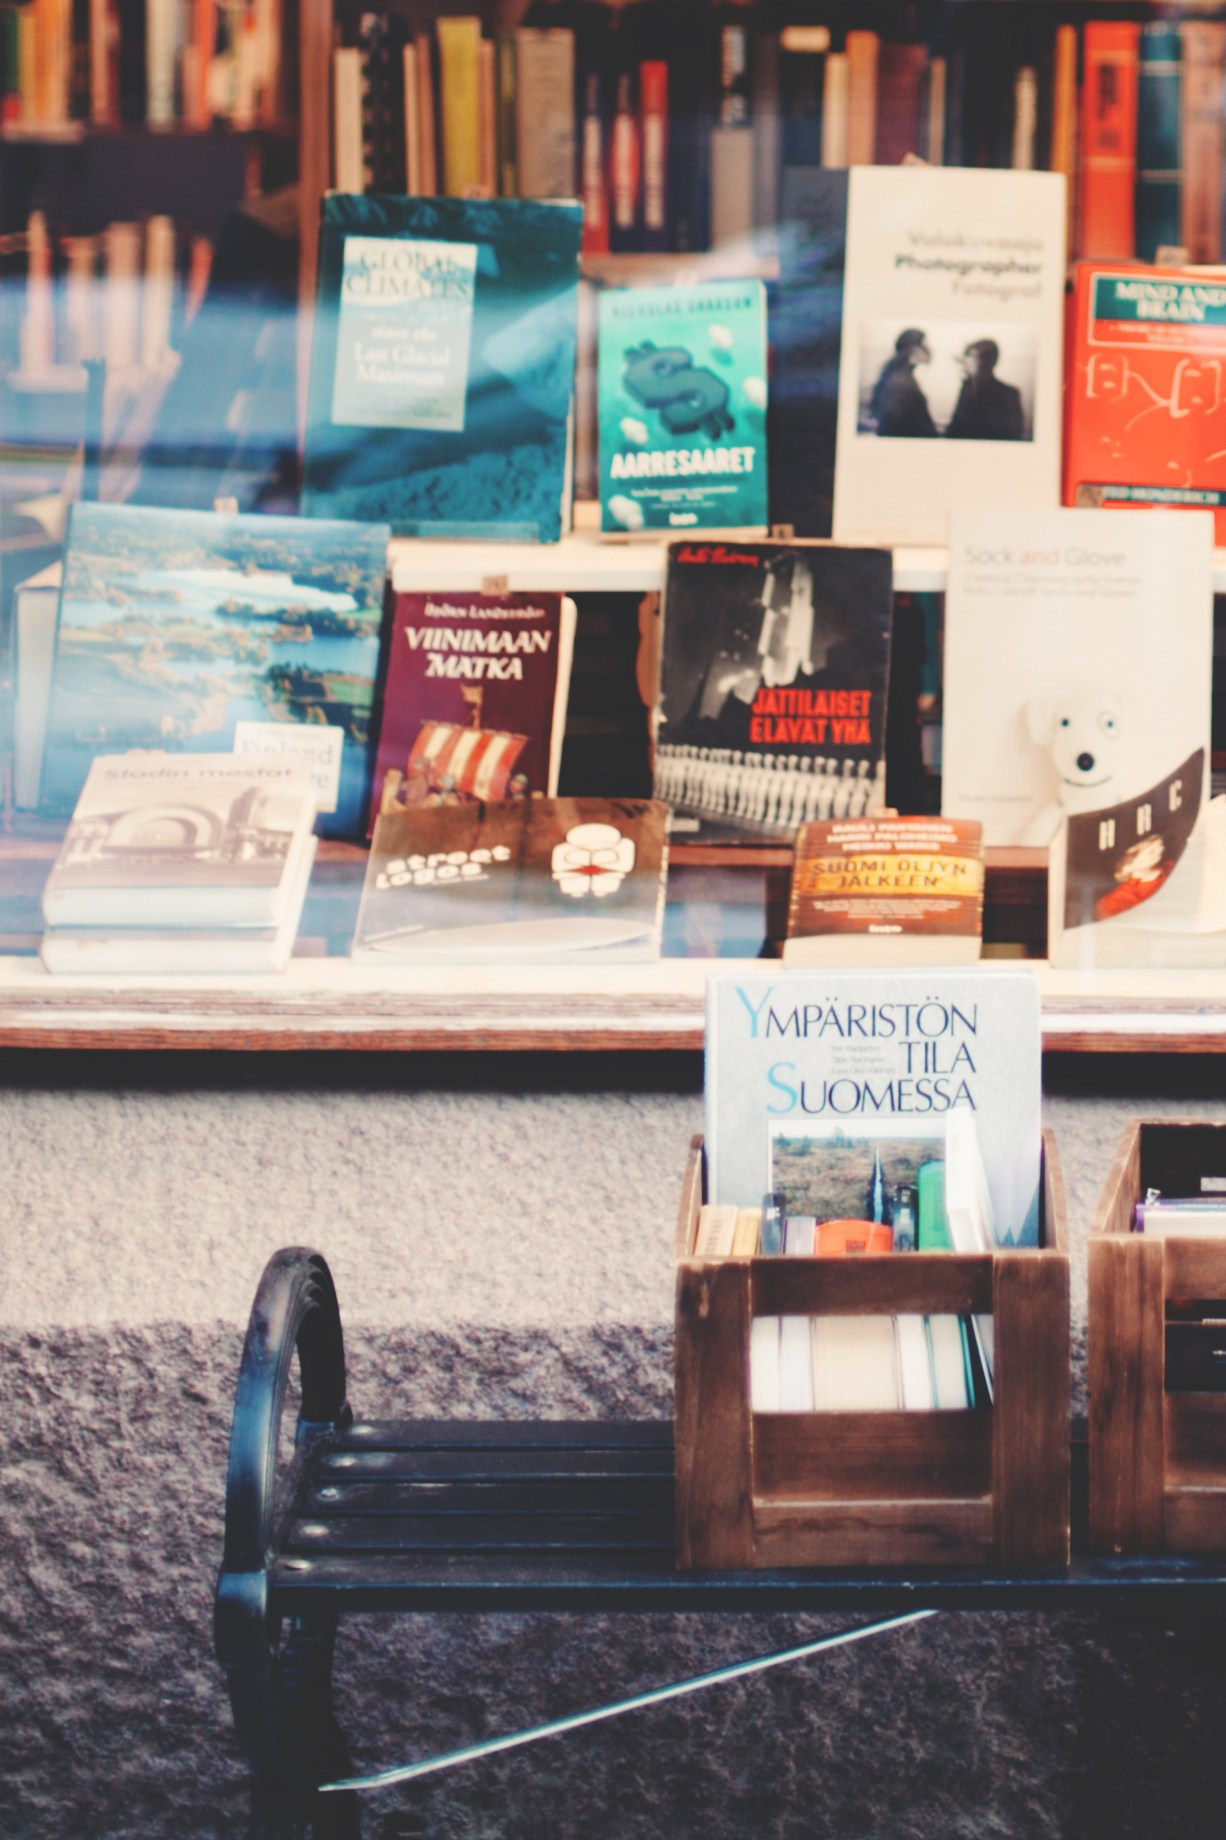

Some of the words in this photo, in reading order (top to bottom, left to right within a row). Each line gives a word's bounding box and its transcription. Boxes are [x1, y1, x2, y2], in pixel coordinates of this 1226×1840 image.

[360, 249, 457, 274] GLOBAL
[895, 254, 1042, 277] Photographer
[1116, 281, 1179, 302] MIND
[1136, 299, 1206, 321] BRAIN
[610, 446, 756, 479] AARRESAARET
[964, 546, 1014, 565] Sock
[1019, 546, 1061, 565] and
[1063, 546, 1127, 566] Glove
[404, 626, 552, 654] VIINIMAAN
[425, 652, 523, 681] MATKA
[385, 844, 512, 875] street
[812, 861, 887, 876] SUOMI
[375, 862, 482, 890] logos
[734, 987, 978, 1039] YMPÄRISTÖN
[898, 1041, 978, 1074] TILA
[766, 1061, 978, 1114] SUOMESSA
